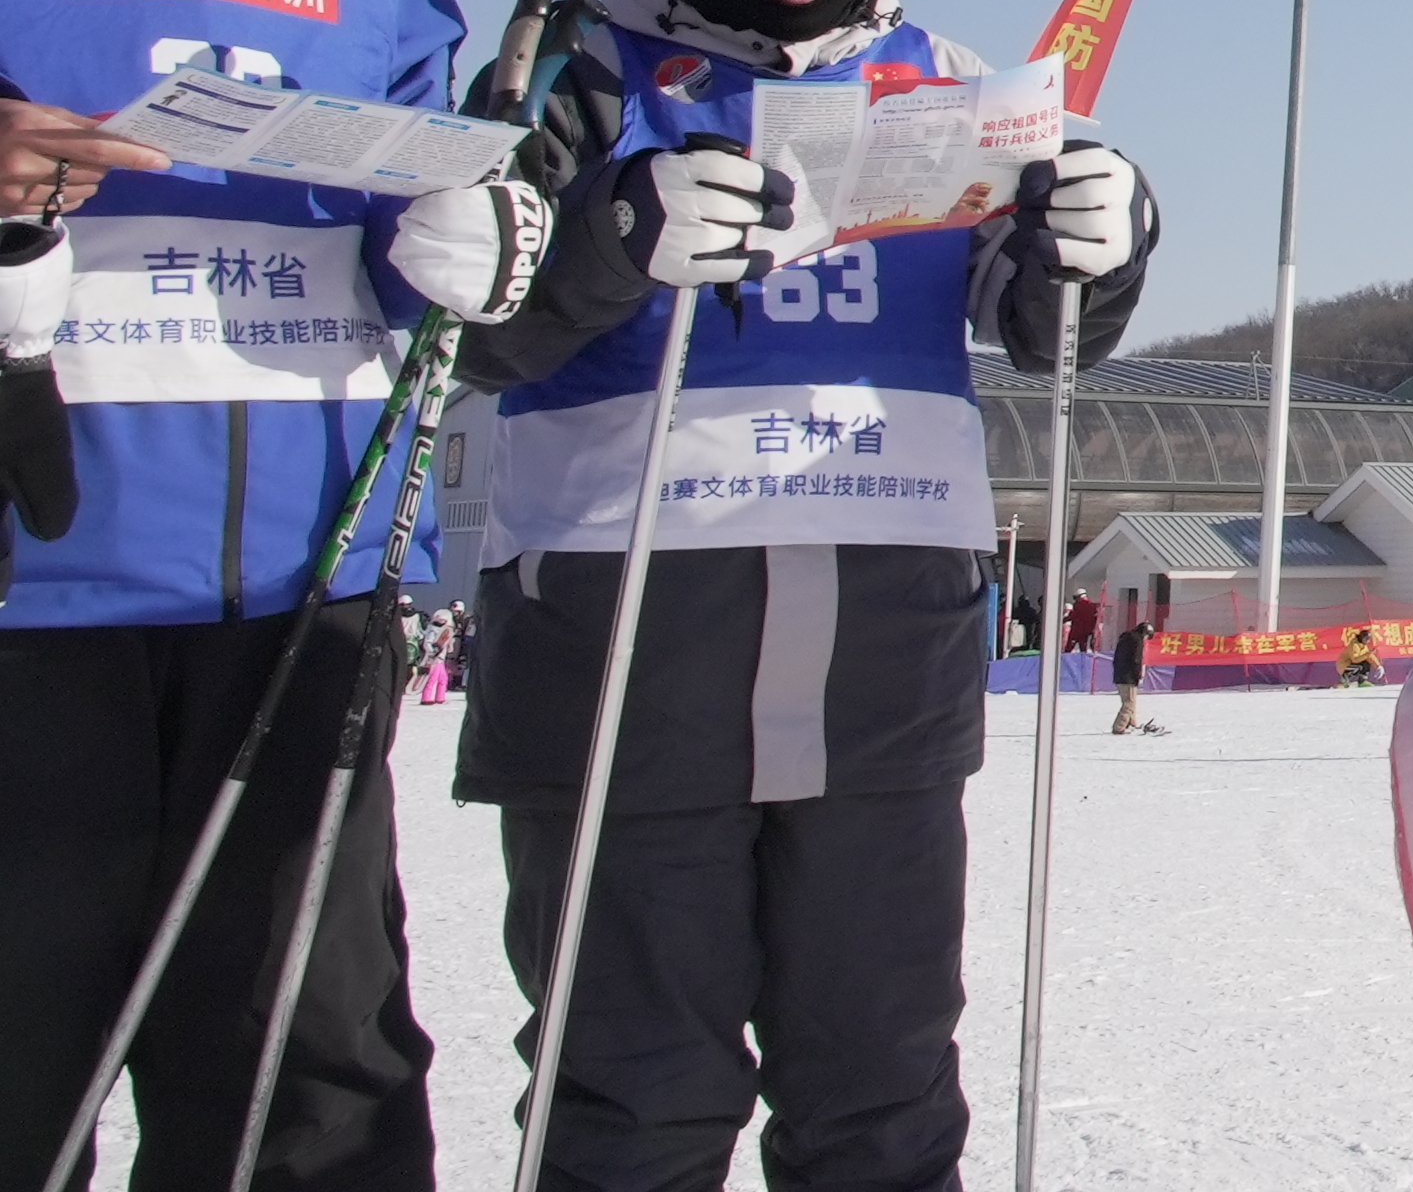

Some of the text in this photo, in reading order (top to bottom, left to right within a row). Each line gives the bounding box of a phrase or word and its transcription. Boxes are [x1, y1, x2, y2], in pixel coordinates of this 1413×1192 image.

[978, 123, 1059, 148] 履行兵役义务
[982, 106, 1059, 133] 响应祖国号召
[143, 246, 308, 300] 吉林省
[762, 239, 880, 324] 63
[419, 310, 463, 428] EXA
[751, 412, 887, 455] 吉林省
